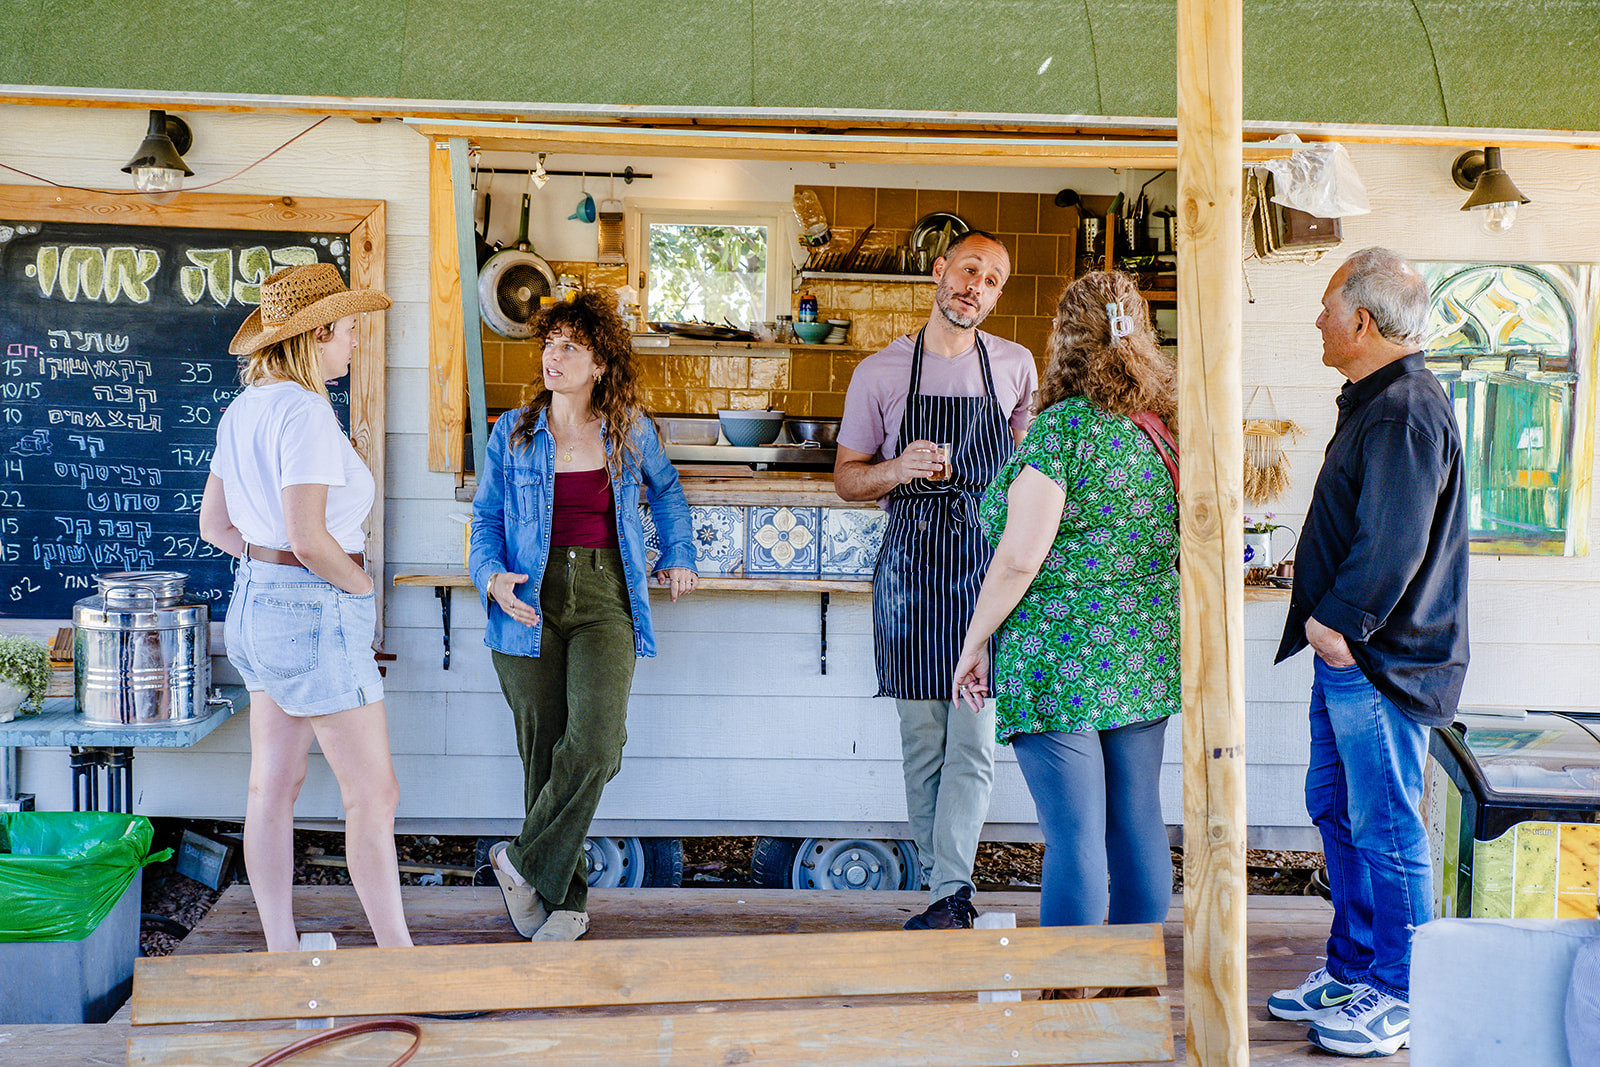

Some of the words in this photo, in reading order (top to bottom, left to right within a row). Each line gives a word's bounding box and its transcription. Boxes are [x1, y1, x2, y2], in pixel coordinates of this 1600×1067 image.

[7, 343, 38, 358] חם
[48, 329, 129, 353] שתיה
[2, 359, 28, 377] 15
[180, 362, 213, 384] 35
[0, 382, 42, 399] 10/15
[92, 384, 157, 412] קפה
[3, 407, 23, 424] 10
[179, 405, 211, 424] 30
[68, 435, 105, 459] קר
[5, 459, 24, 480] 14
[54, 462, 161, 490] היביסקוס
[0, 490, 26, 507] 22
[87, 492, 160, 511] סחוט
[1, 517, 20, 534] 15
[54, 516, 92, 544] קר
[98, 519, 152, 547] קפה
